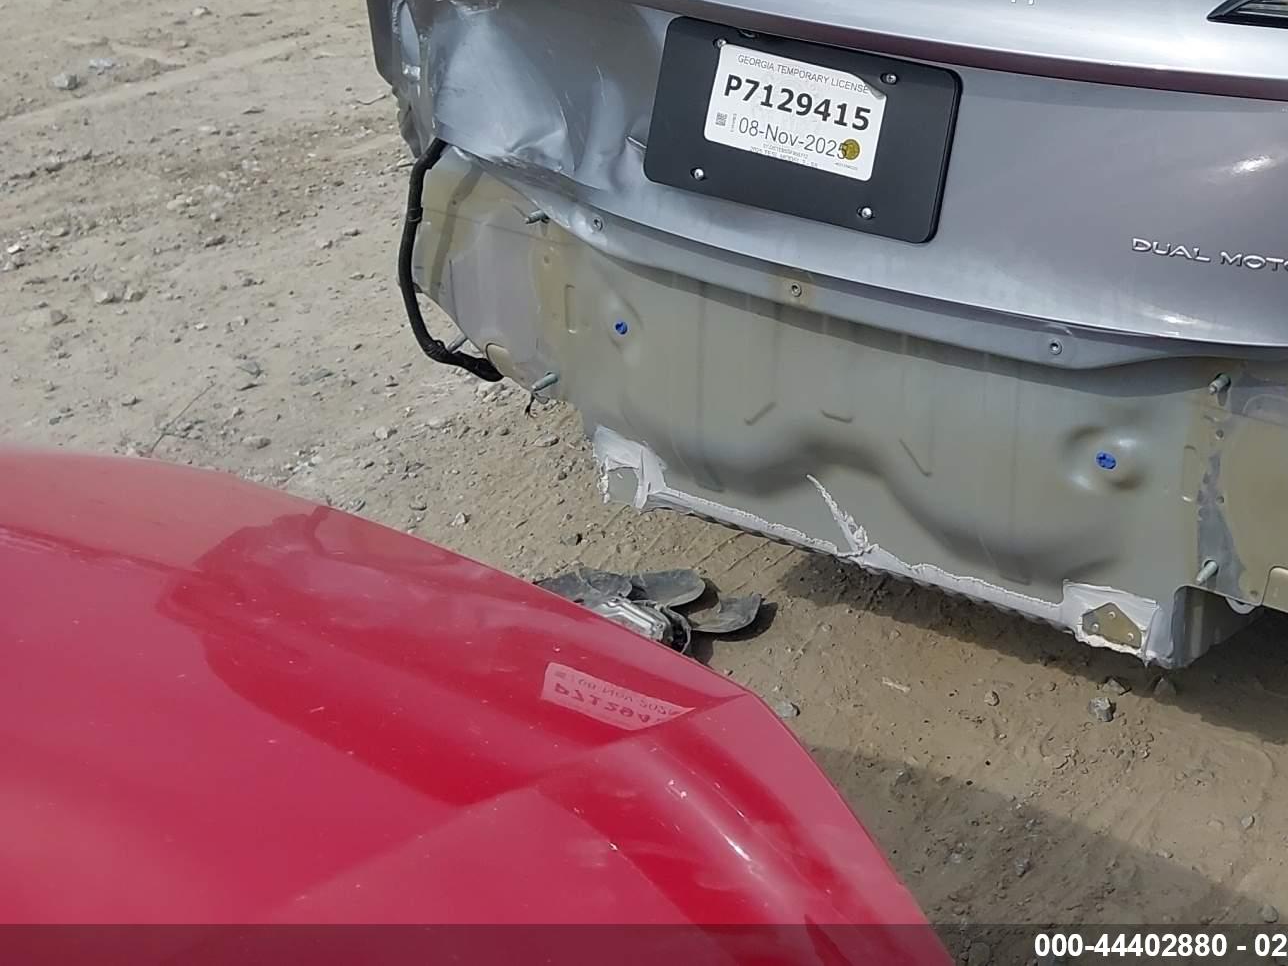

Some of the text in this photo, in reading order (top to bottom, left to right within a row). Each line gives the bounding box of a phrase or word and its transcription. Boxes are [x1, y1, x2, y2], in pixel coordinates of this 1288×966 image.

[737, 54, 869, 95] GEORGIA TEMPORARY LICENSE
[723, 74, 872, 132] P7129415
[1132, 238, 1211, 263] DUAL
